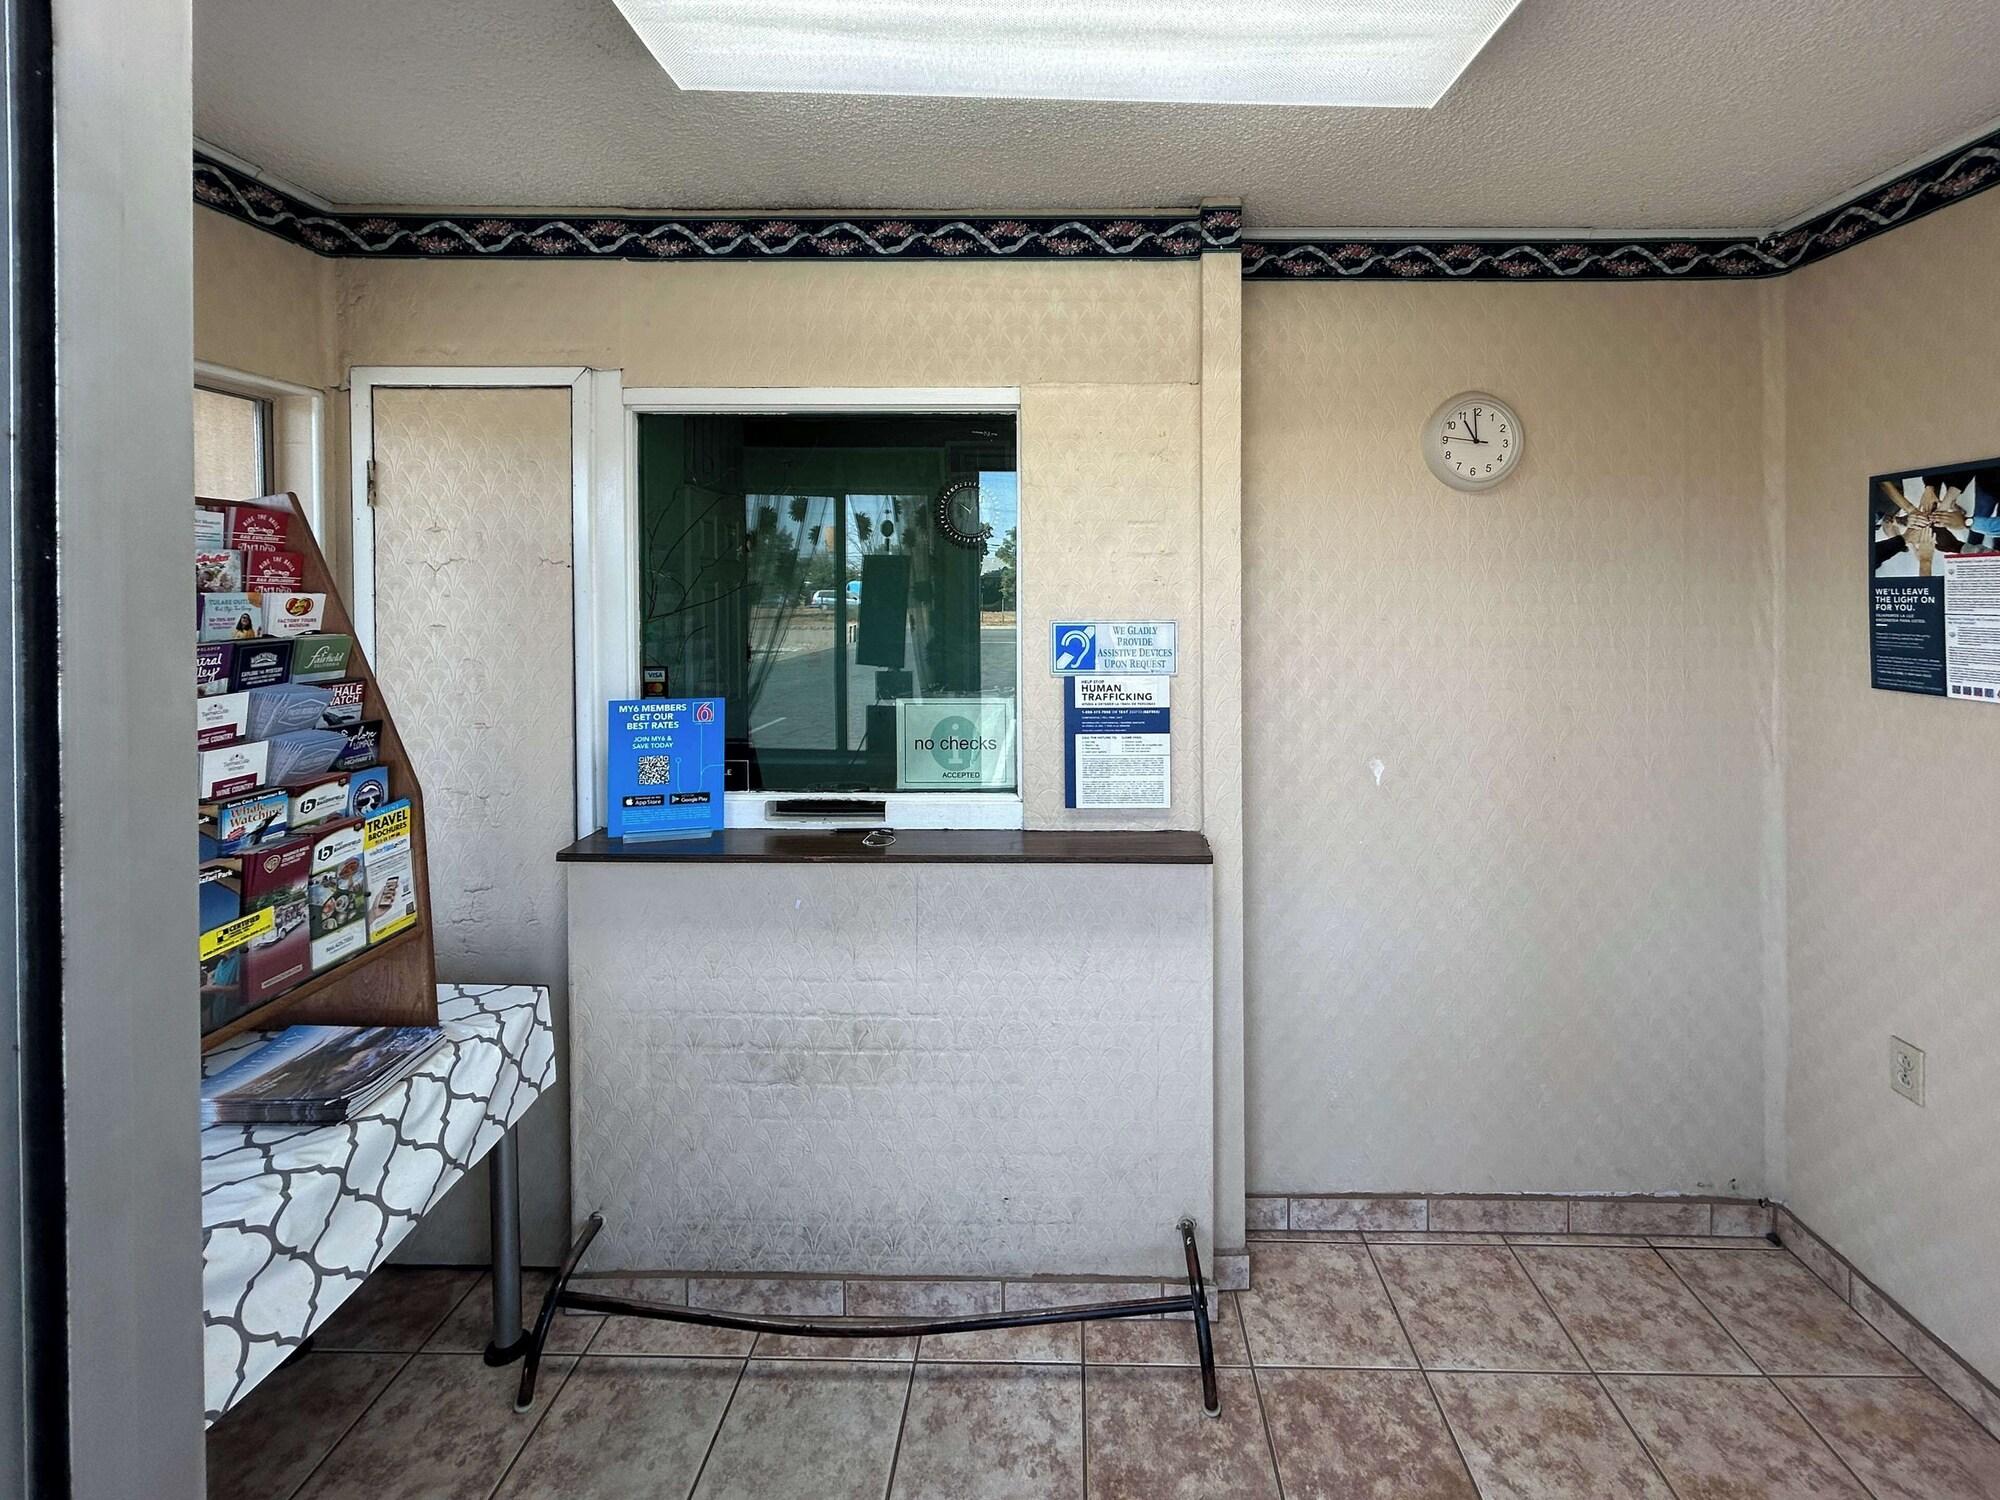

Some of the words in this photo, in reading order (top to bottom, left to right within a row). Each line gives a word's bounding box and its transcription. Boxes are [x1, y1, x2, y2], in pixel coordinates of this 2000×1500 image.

[1458, 412, 1466, 420] 11
[1473, 408, 1482, 416] 12
[1490, 414, 1494, 422] 1
[1447, 421, 1456, 430] 10
[1500, 424, 1506, 432] 2
[1442, 436, 1448, 444] 9
[1503, 440, 1508, 448] 3
[1445, 451, 1451, 460] 8
[1497, 454, 1502, 462] 4
[1456, 462, 1462, 470] 7
[1486, 464, 1492, 472] 5
[1470, 468, 1476, 476] 6
[1876, 596, 1892, 604] THE
[1894, 596, 1918, 604] LIGHT
[1920, 596, 1936, 604] ON
[1894, 604, 1916, 612] YOU.
[332, 684, 364, 696] HALE
[1082, 684, 1122, 692] HUMAN
[1082, 692, 1152, 701] TRAFFICKING
[641, 704, 687, 712] MEMBERS
[653, 712, 674, 720] OUR
[626, 722, 649, 730] BEST
[652, 721, 680, 729] RATES
[914, 739, 934, 750] no
[940, 736, 997, 750] checks
[366, 810, 408, 833] TRAVEL
[368, 822, 408, 842] BROCHURES
